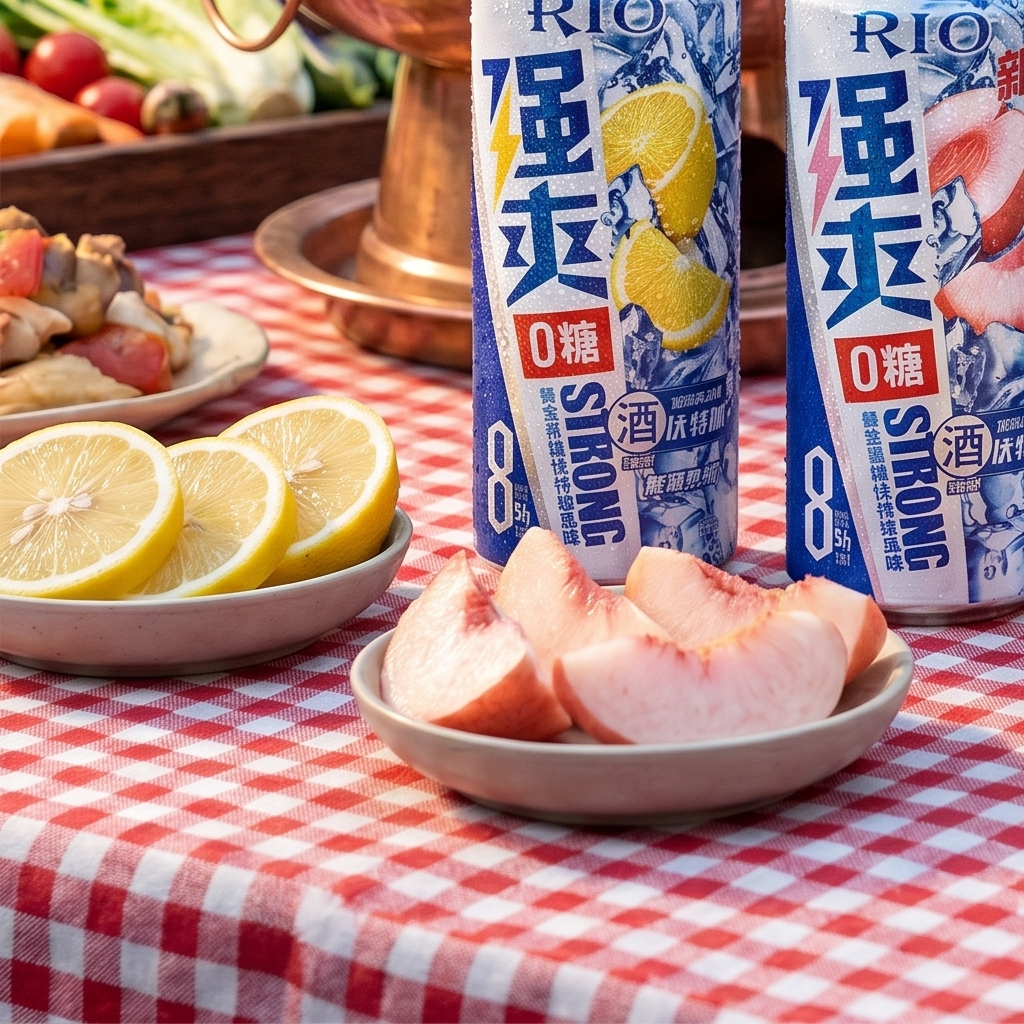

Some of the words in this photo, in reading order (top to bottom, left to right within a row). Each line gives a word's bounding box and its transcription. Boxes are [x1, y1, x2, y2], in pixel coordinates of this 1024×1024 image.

[850, 10, 991, 59] RIO
[482, 48, 609, 308] 强爽
[798, 69, 933, 330] 强爽
[528, 320, 600, 368] 0糖
[850, 342, 924, 392] 0糖
[617, 401, 657, 445] 酒
[942, 423, 984, 468] 酒
[560, 381, 626, 547] STRONG
[883, 404, 950, 572] STRONG
